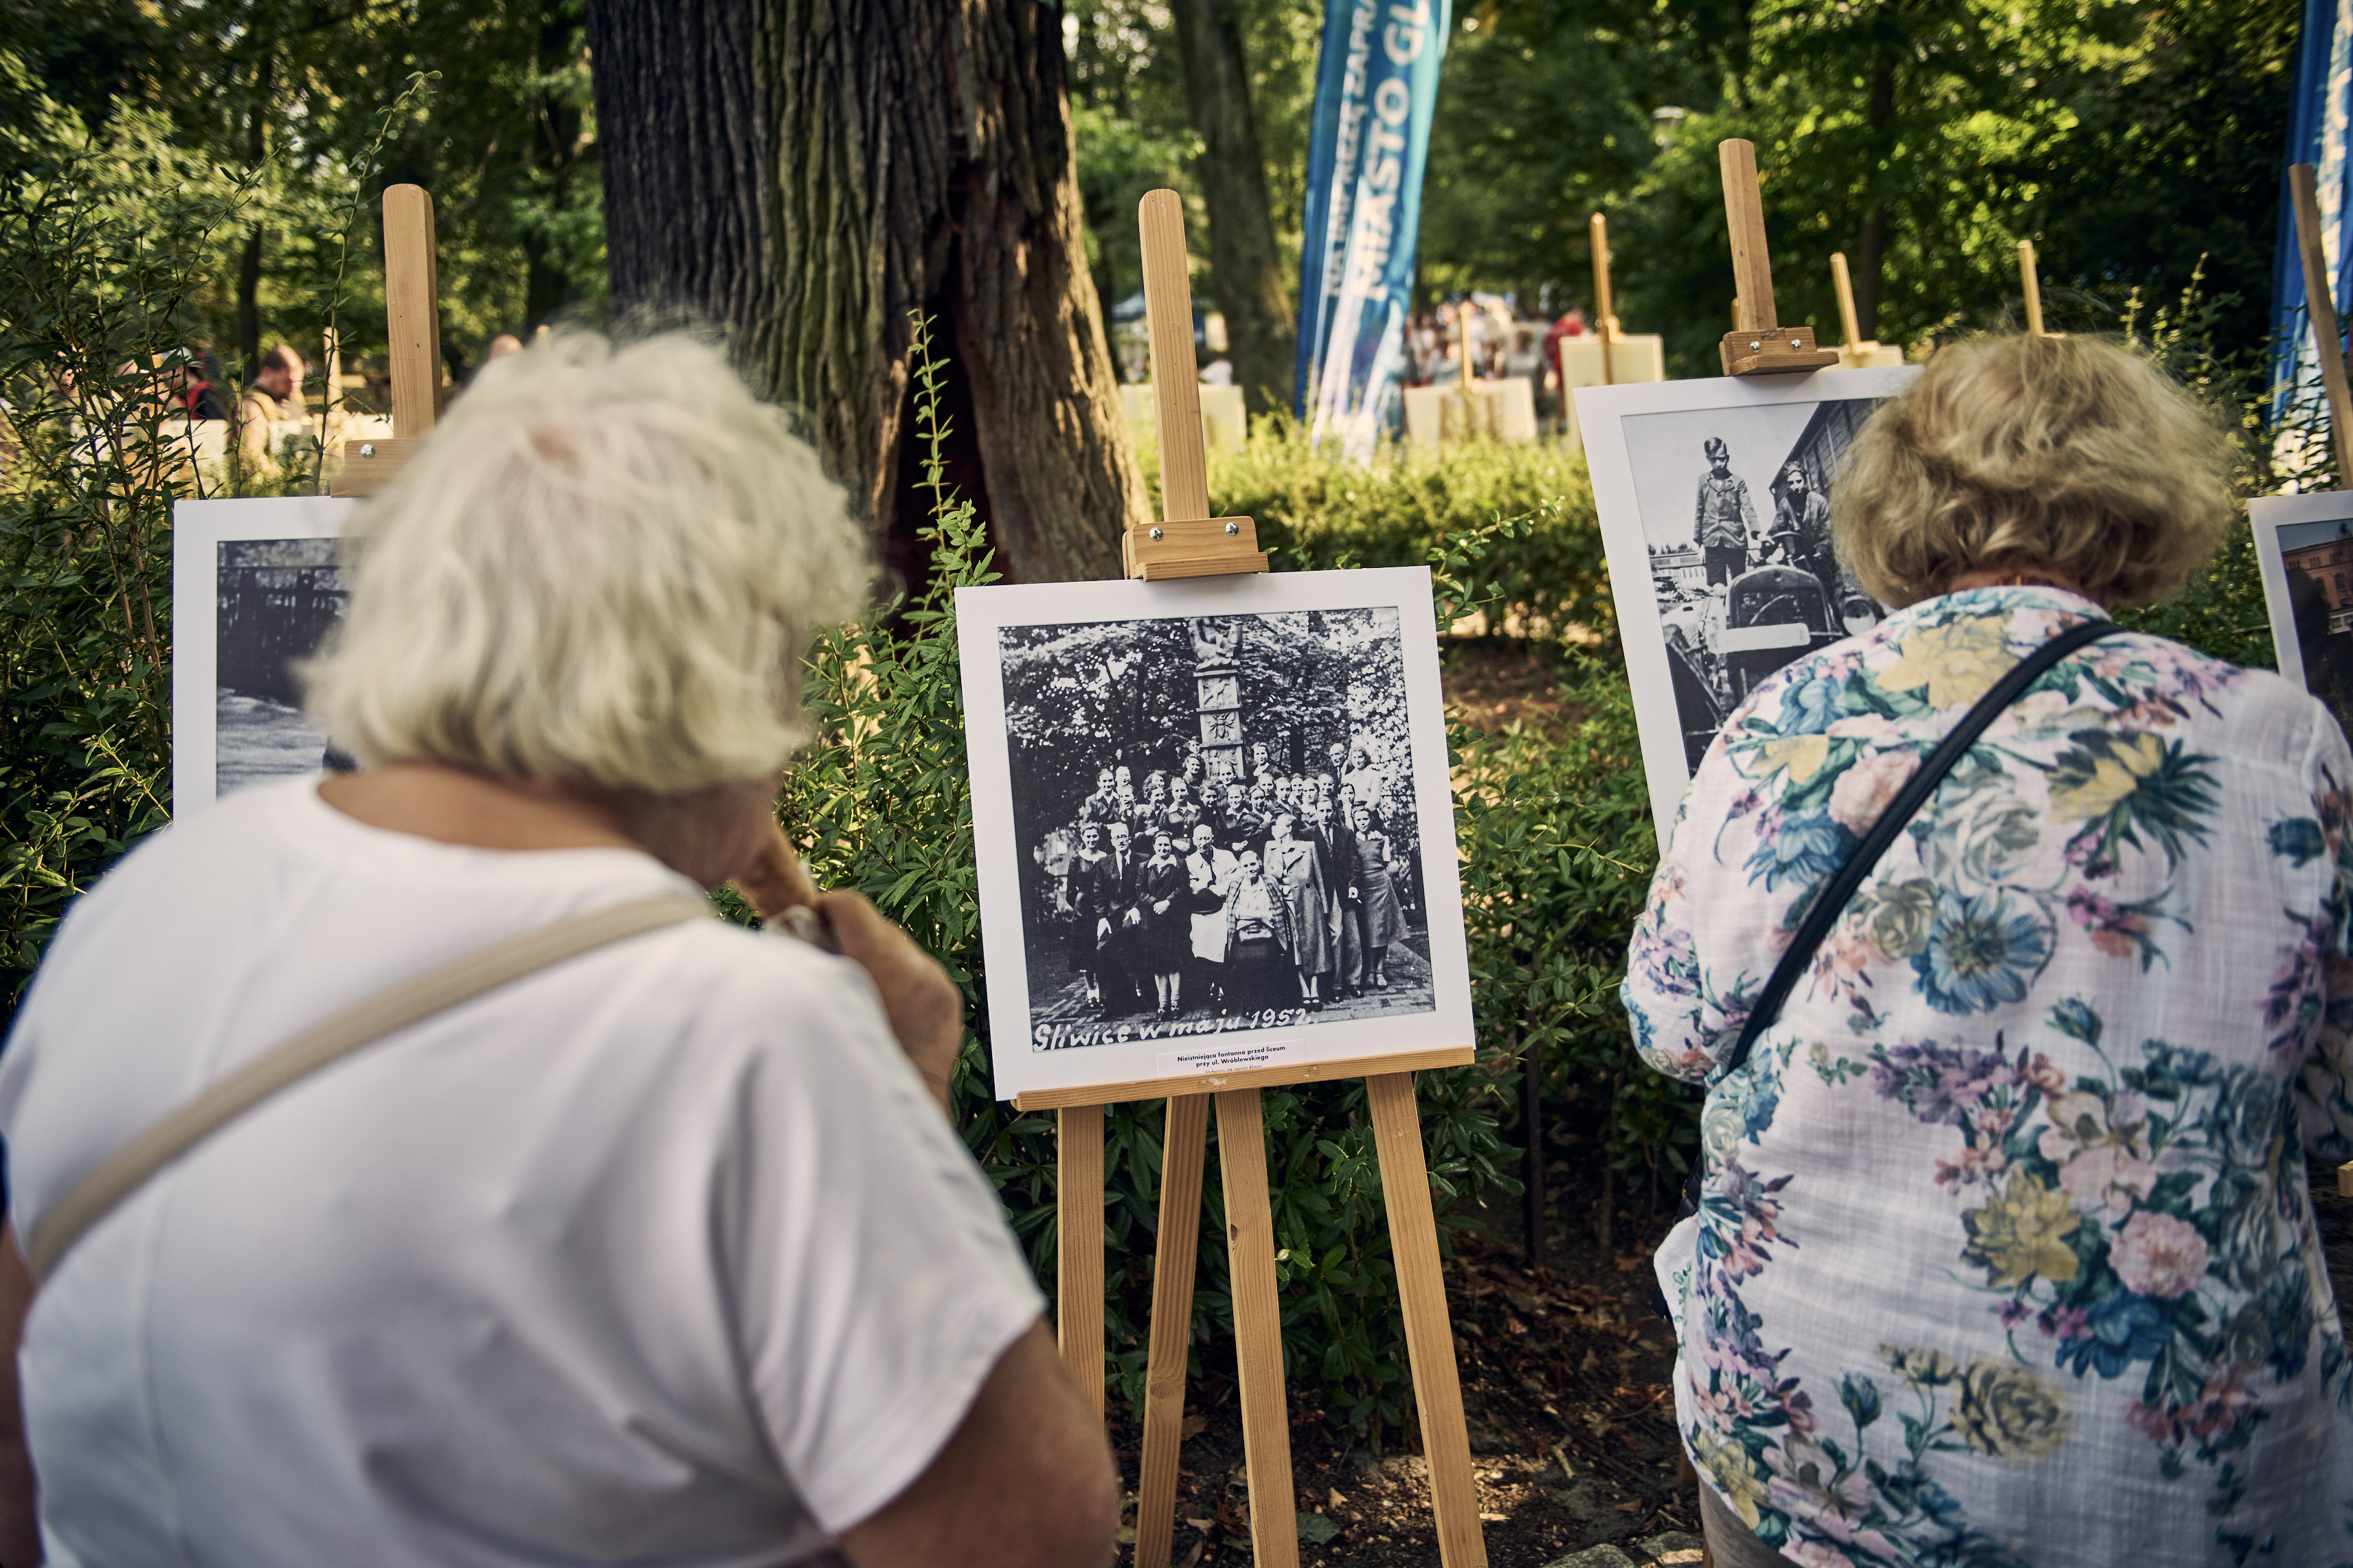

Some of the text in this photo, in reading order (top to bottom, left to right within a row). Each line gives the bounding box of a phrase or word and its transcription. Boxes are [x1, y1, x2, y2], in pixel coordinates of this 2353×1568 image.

[1349, 77, 1410, 303] MIASTO
[1139, 1024, 1162, 1040] w
[1169, 1008, 1241, 1037] maju
[1177, 1052, 1217, 1062] Nieistniejąca
[1247, 1047, 1265, 1056] przed
[1196, 1060, 1211, 1069] przy
[1221, 1054, 1269, 1064] Wróblewskiego
